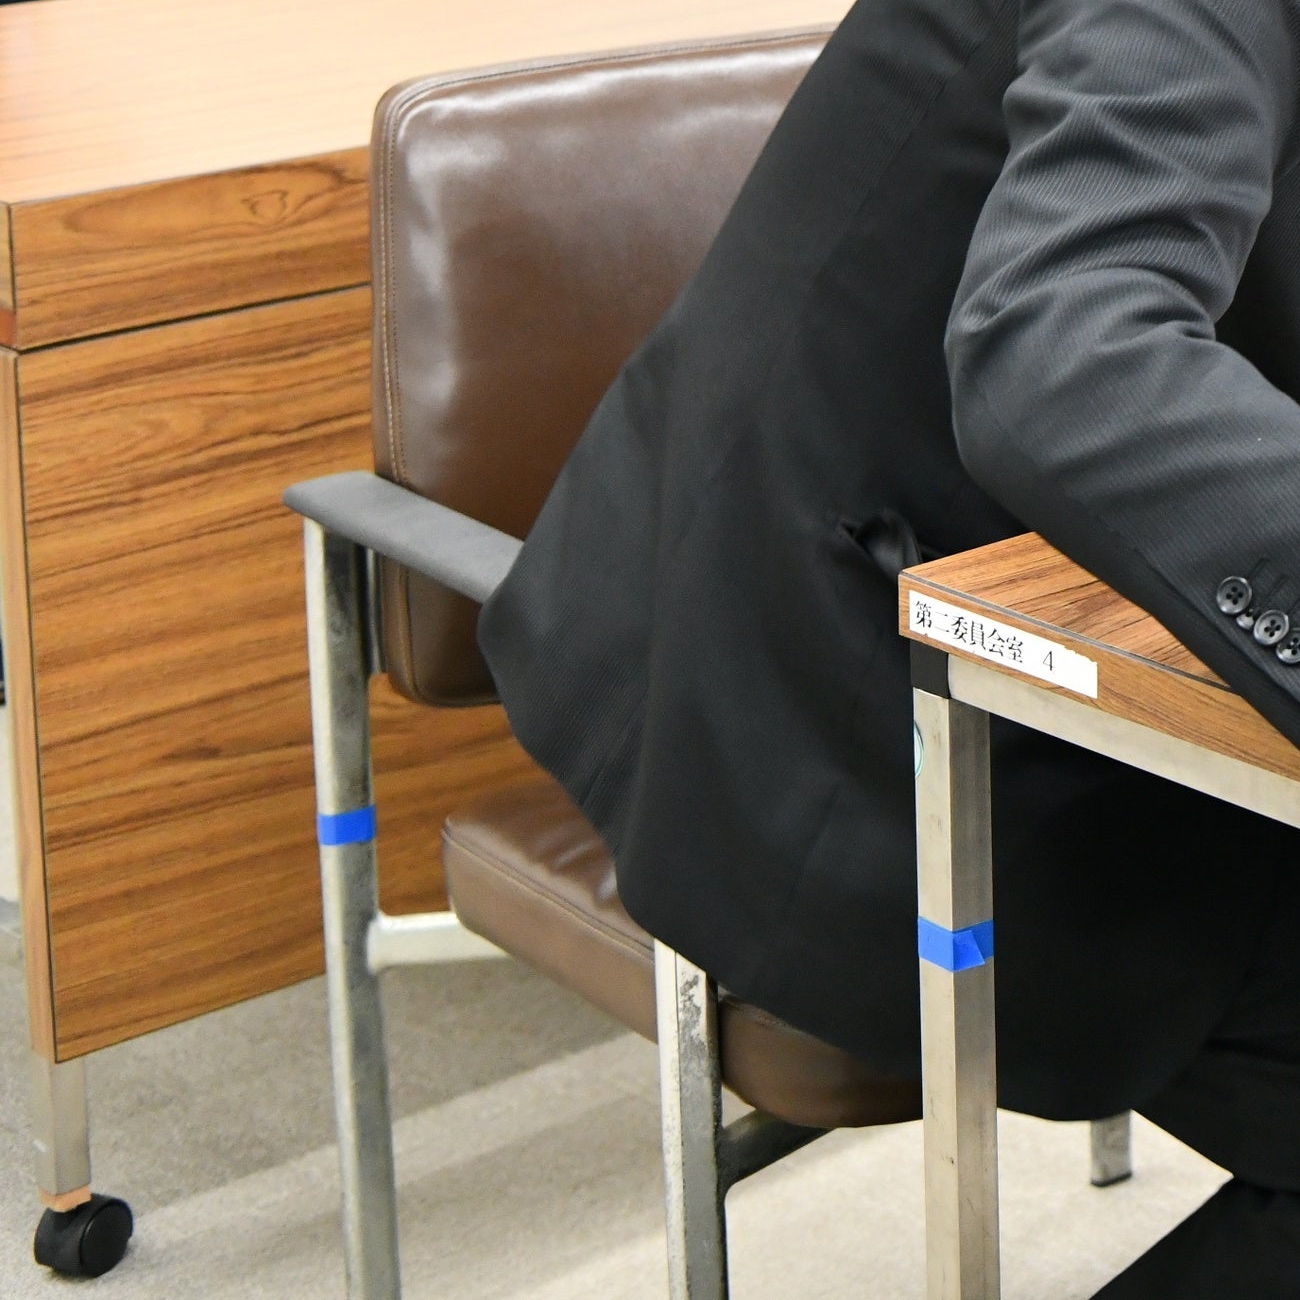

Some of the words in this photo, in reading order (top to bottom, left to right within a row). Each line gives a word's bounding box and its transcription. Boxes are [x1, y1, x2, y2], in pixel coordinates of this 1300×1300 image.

[916, 601, 1023, 663] 第二委員会室
[1042, 651, 1055, 671] 4
